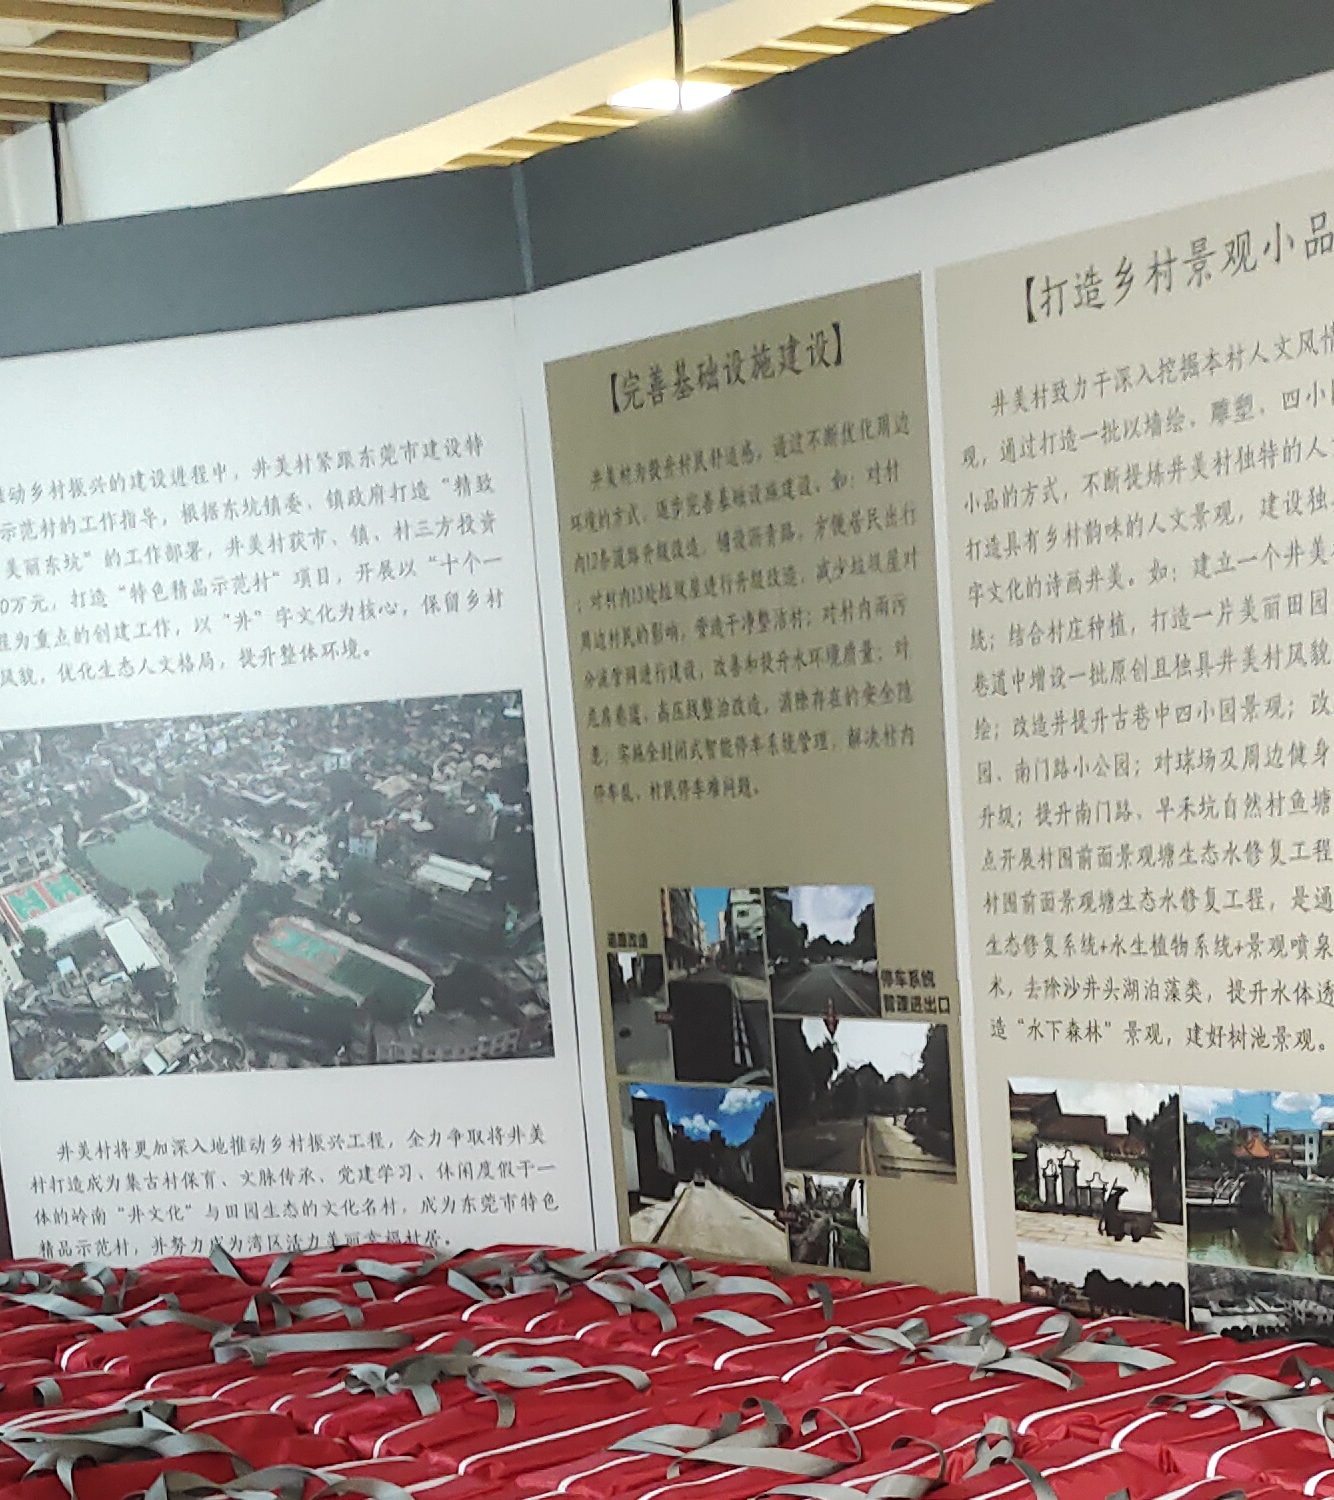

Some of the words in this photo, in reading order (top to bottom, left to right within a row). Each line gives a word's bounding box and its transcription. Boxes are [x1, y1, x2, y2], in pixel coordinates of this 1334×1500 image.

[610, 321, 843, 414] 【完善基础设施建设】
